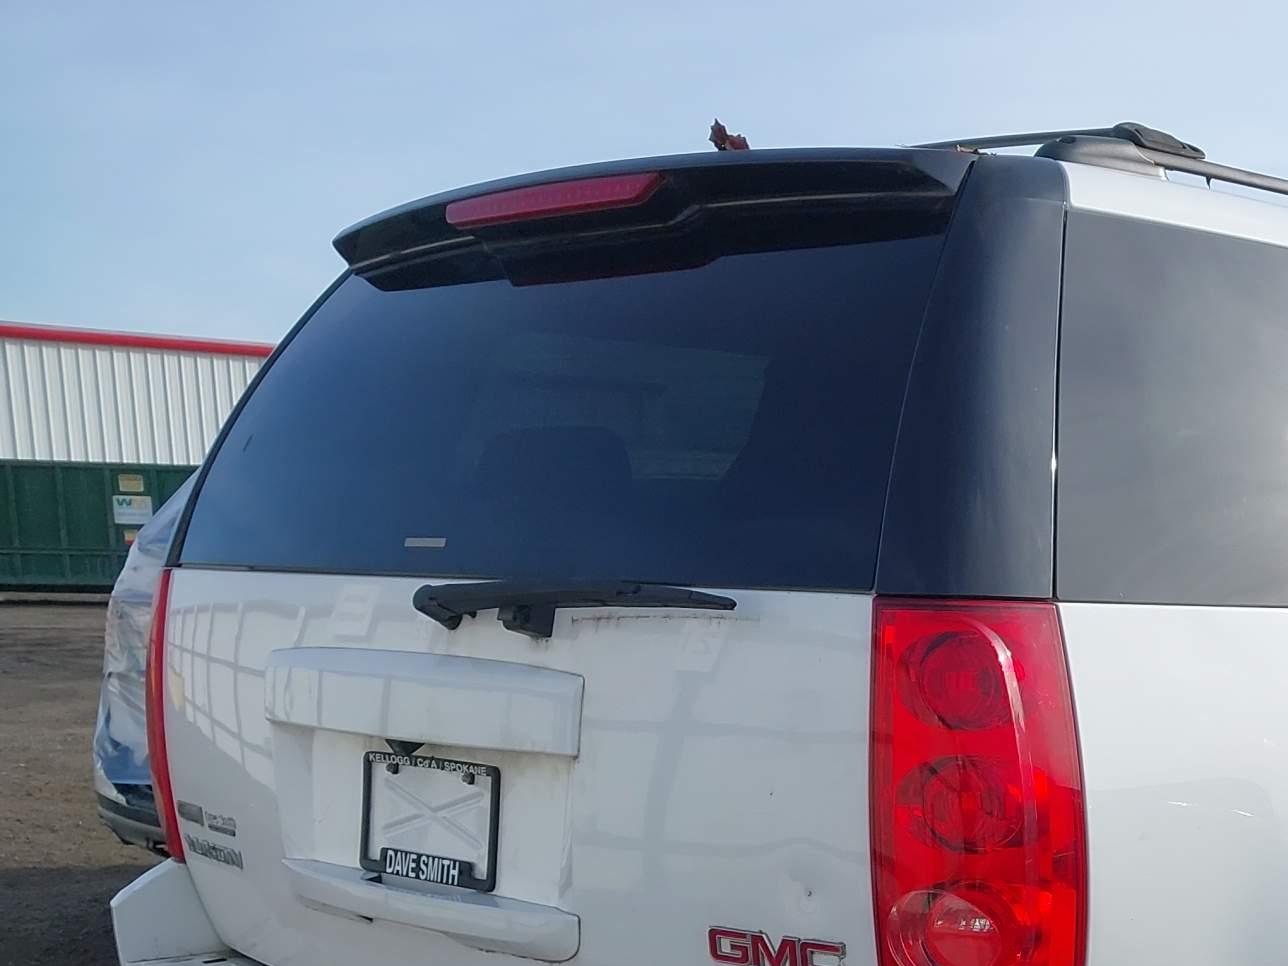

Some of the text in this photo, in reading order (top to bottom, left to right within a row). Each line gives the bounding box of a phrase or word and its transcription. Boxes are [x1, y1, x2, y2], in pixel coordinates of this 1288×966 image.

[368, 752, 411, 766] KELLOGG
[444, 761, 488, 777] SPOKANE
[385, 849, 460, 886] DAVE SMITH
